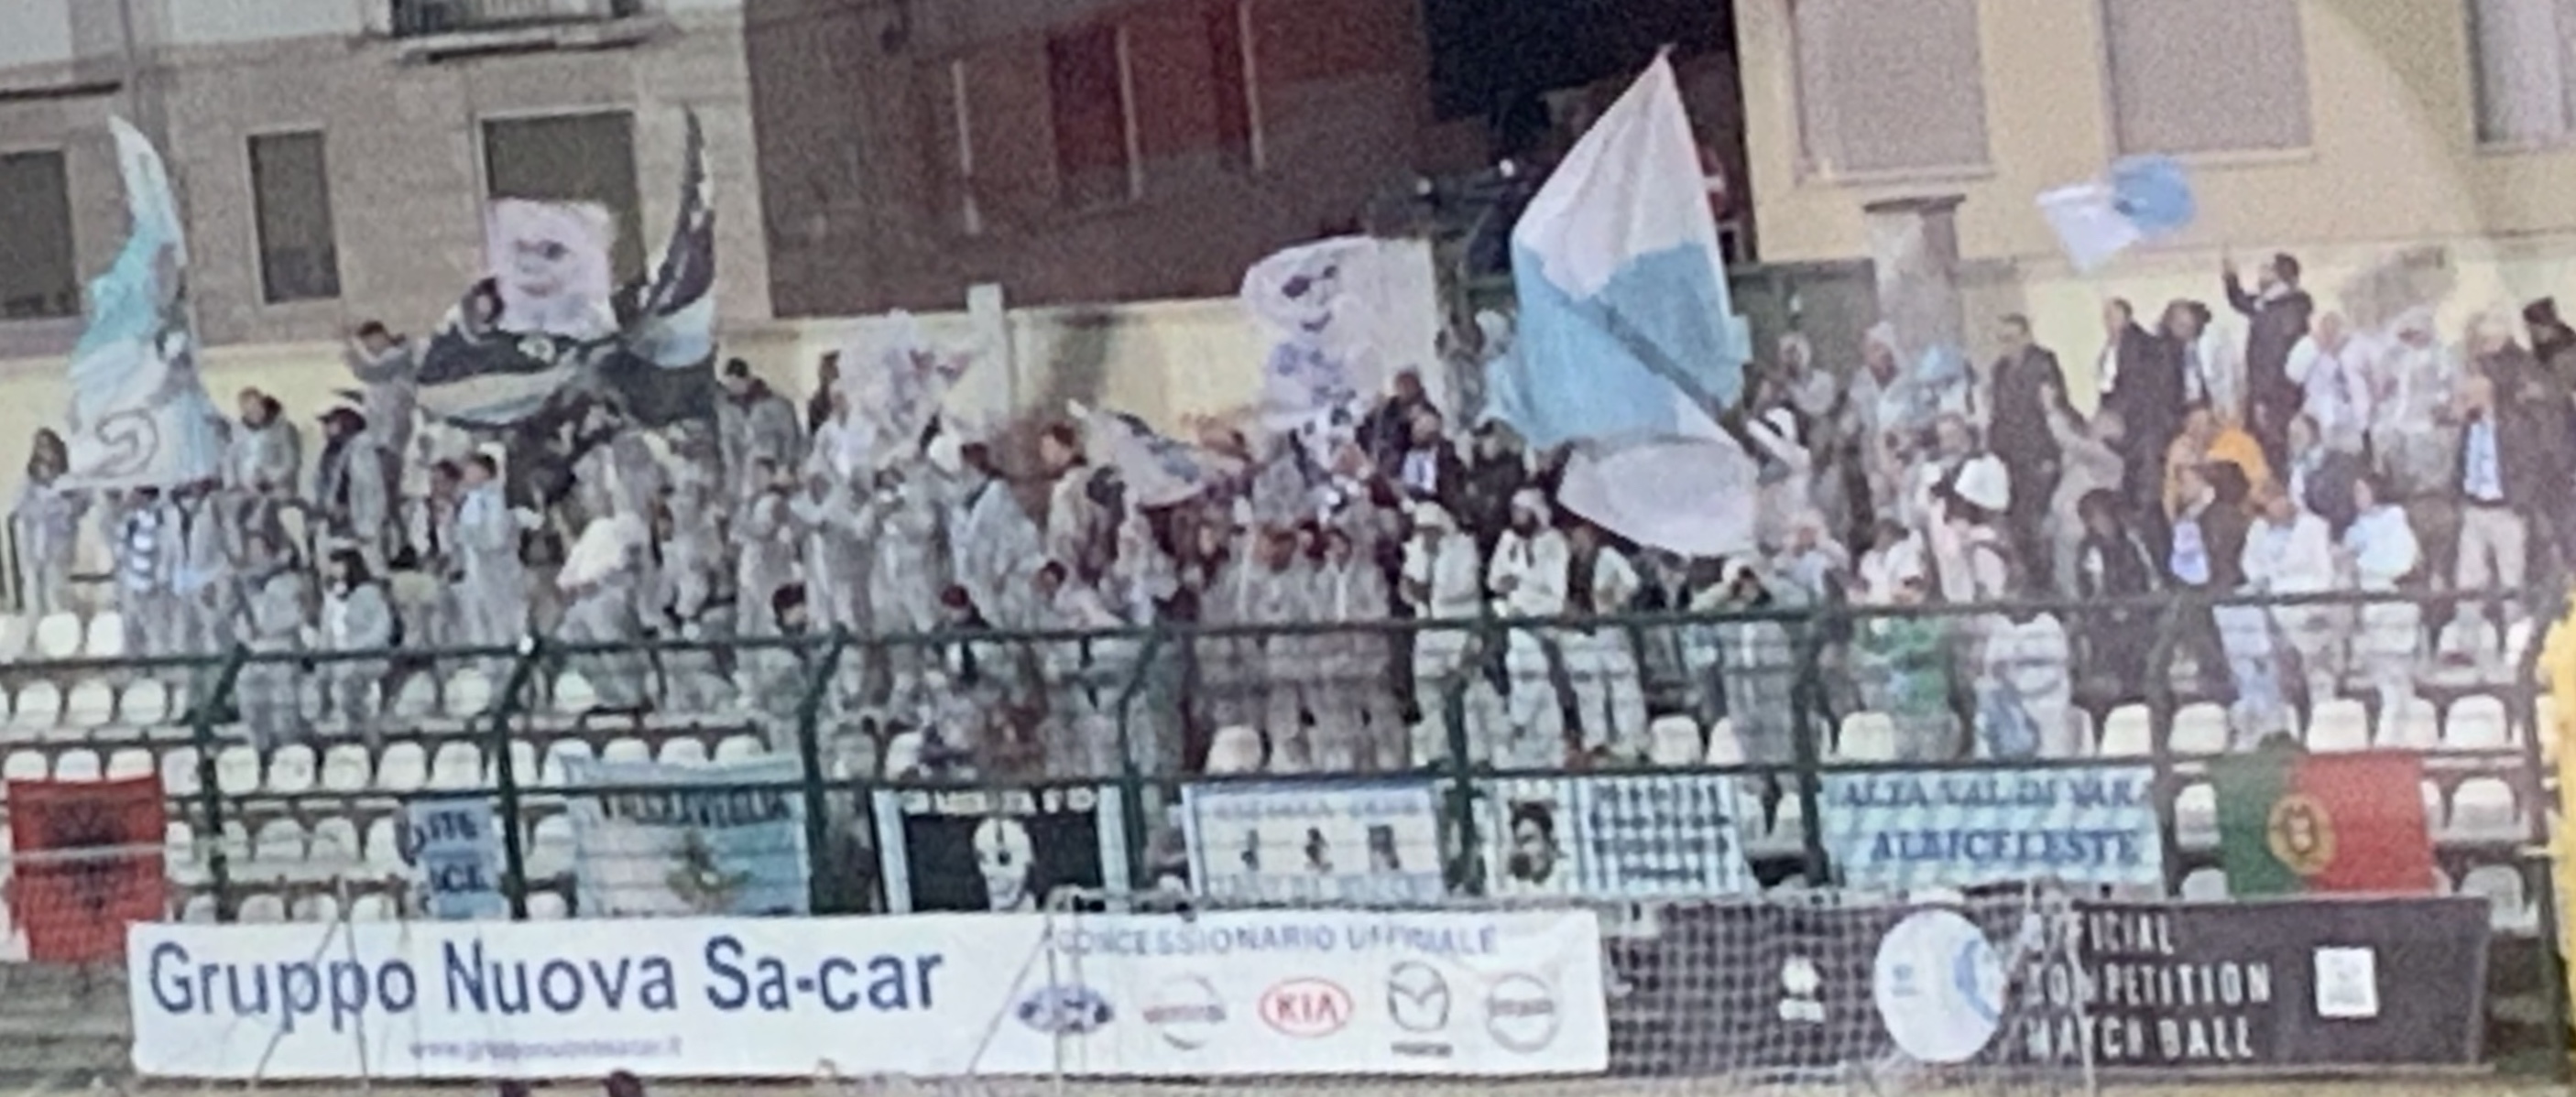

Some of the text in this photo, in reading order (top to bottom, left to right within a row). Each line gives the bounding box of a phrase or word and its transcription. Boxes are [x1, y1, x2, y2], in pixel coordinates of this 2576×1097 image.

[1054, 923, 1500, 956] CONCESSIONARIO UFFICIALE
[149, 933, 947, 1034] Gruppo Nuova Sa-car
[2025, 961, 2271, 1005] COMPETITION
[1276, 994, 1340, 1025] KIA
[2025, 1015, 2254, 1060] MATCH BALL
